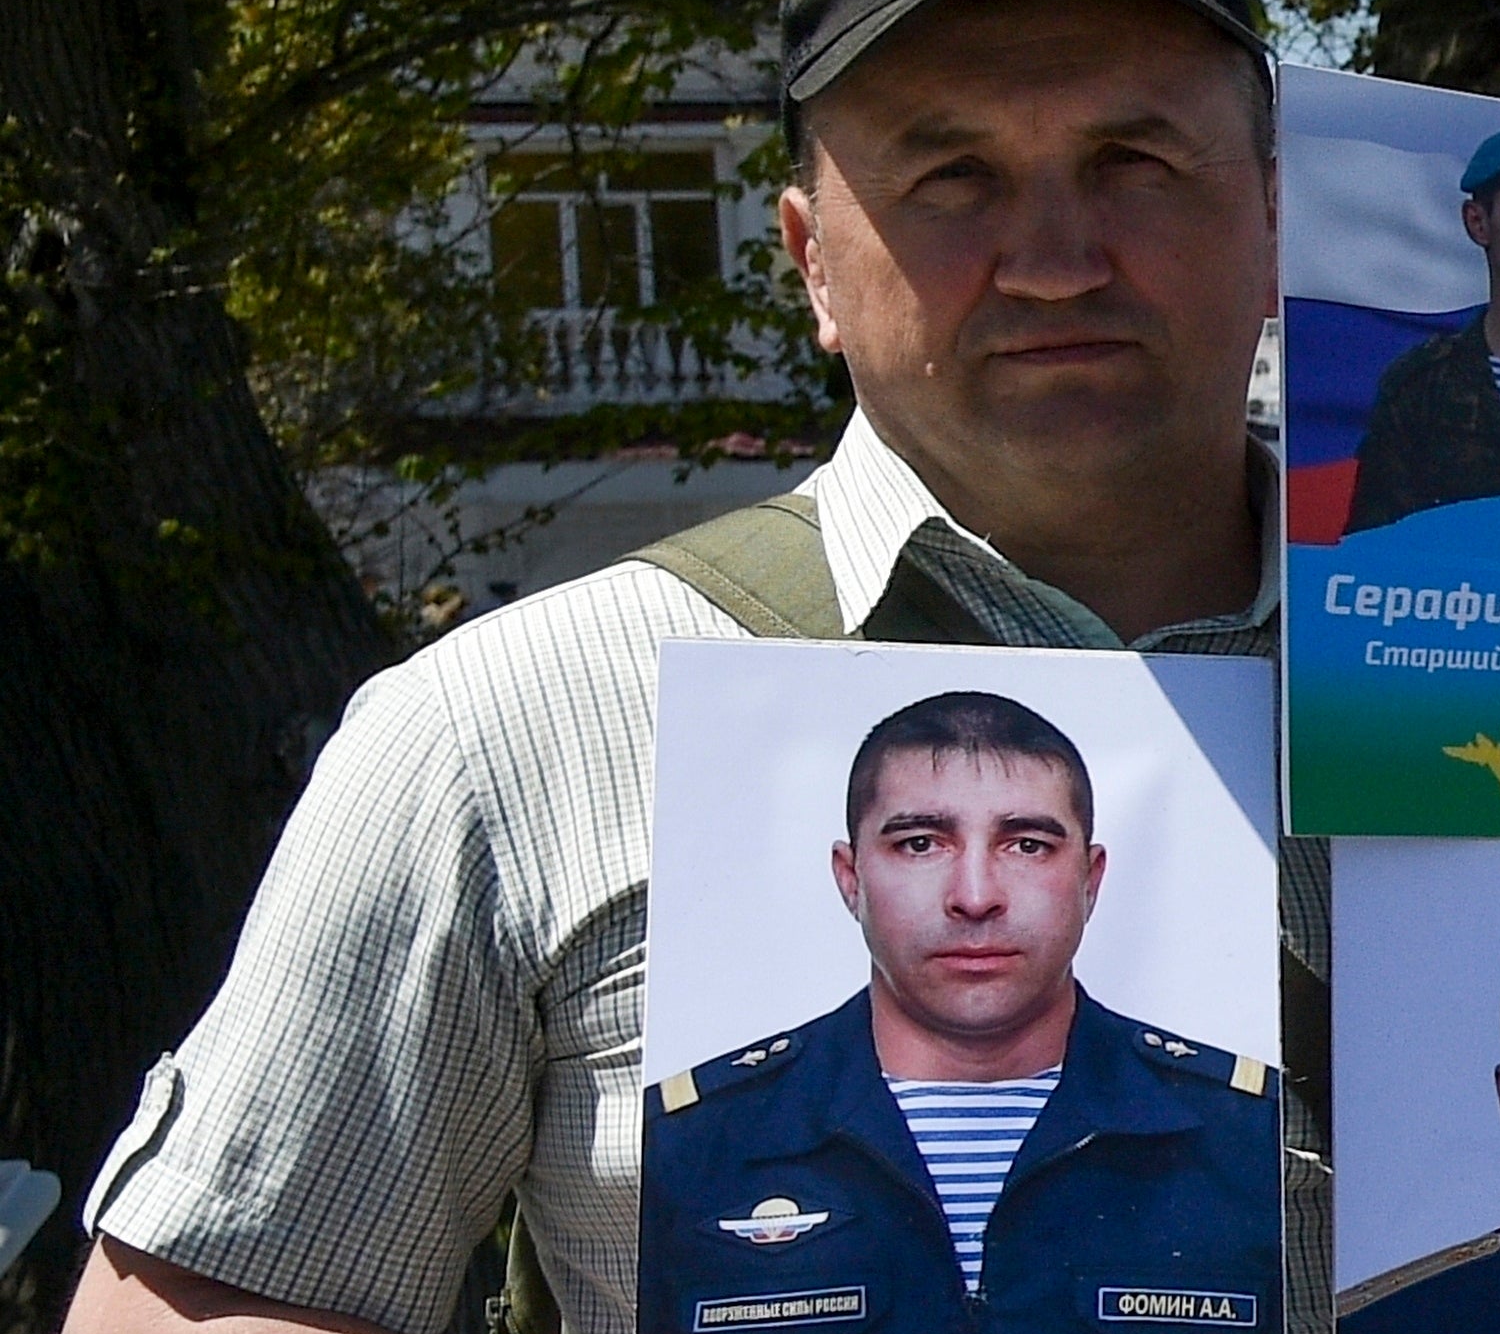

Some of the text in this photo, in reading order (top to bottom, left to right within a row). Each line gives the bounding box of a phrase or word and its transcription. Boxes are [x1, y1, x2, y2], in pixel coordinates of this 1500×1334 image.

[815, 1294, 859, 1315] РОССИИ
[1118, 1293, 1237, 1319] ФОМИН А.А.
